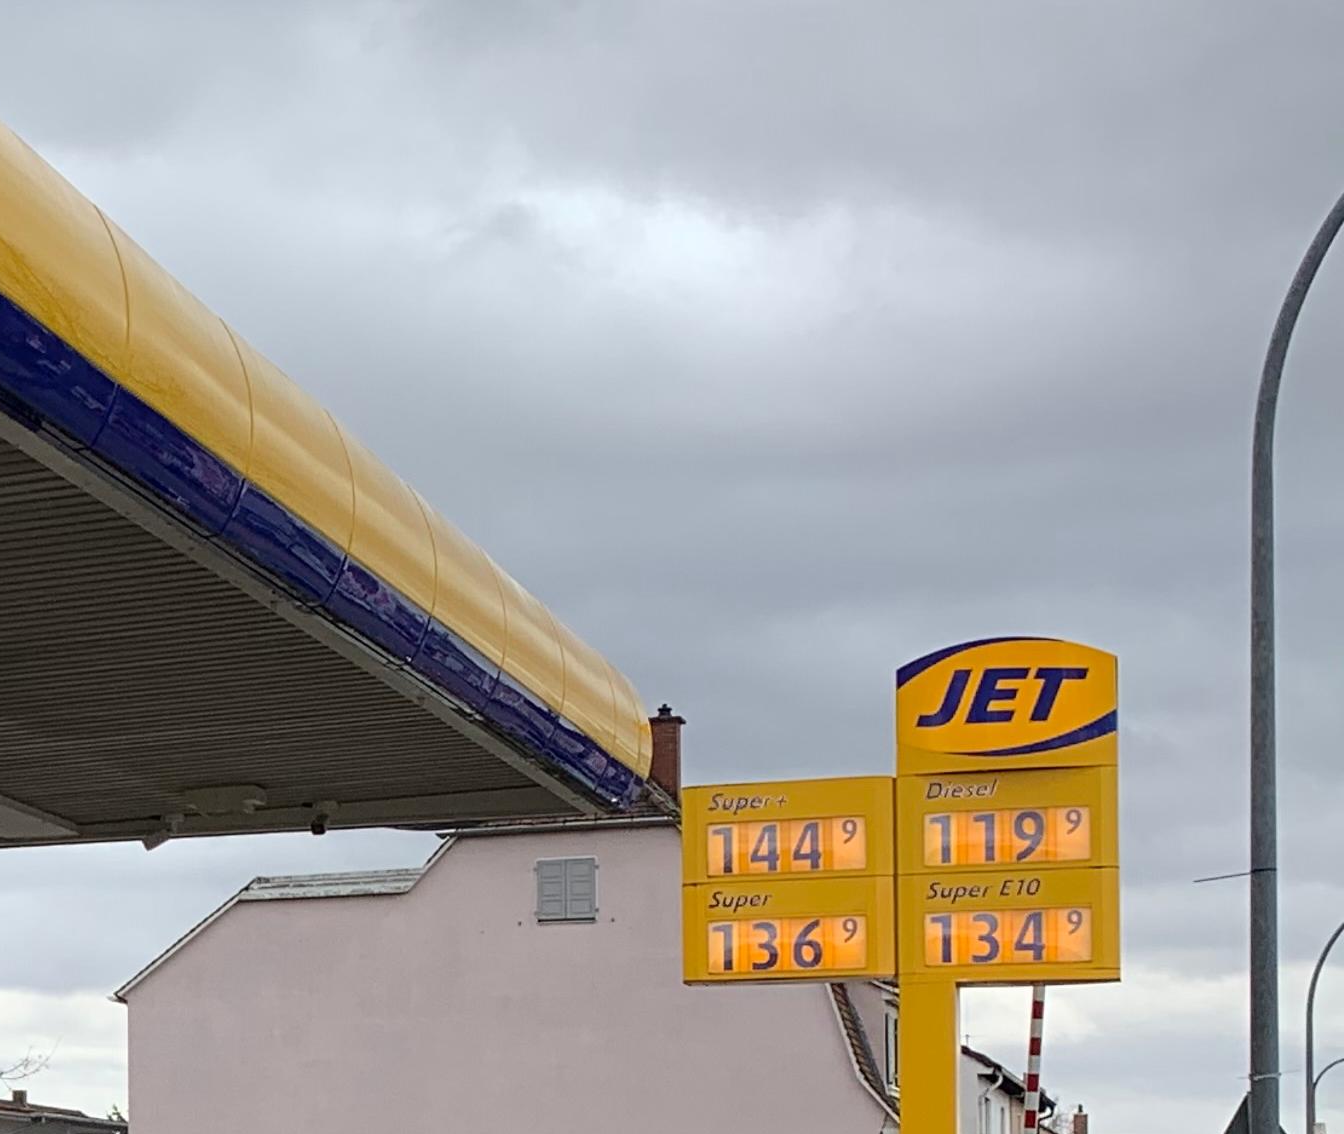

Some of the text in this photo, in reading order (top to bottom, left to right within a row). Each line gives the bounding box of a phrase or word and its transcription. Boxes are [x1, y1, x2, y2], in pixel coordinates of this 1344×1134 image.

[916, 668, 1089, 728] JET
[926, 779, 998, 800] Diesel
[708, 891, 771, 914] Super
[926, 878, 1041, 905] Super E10
